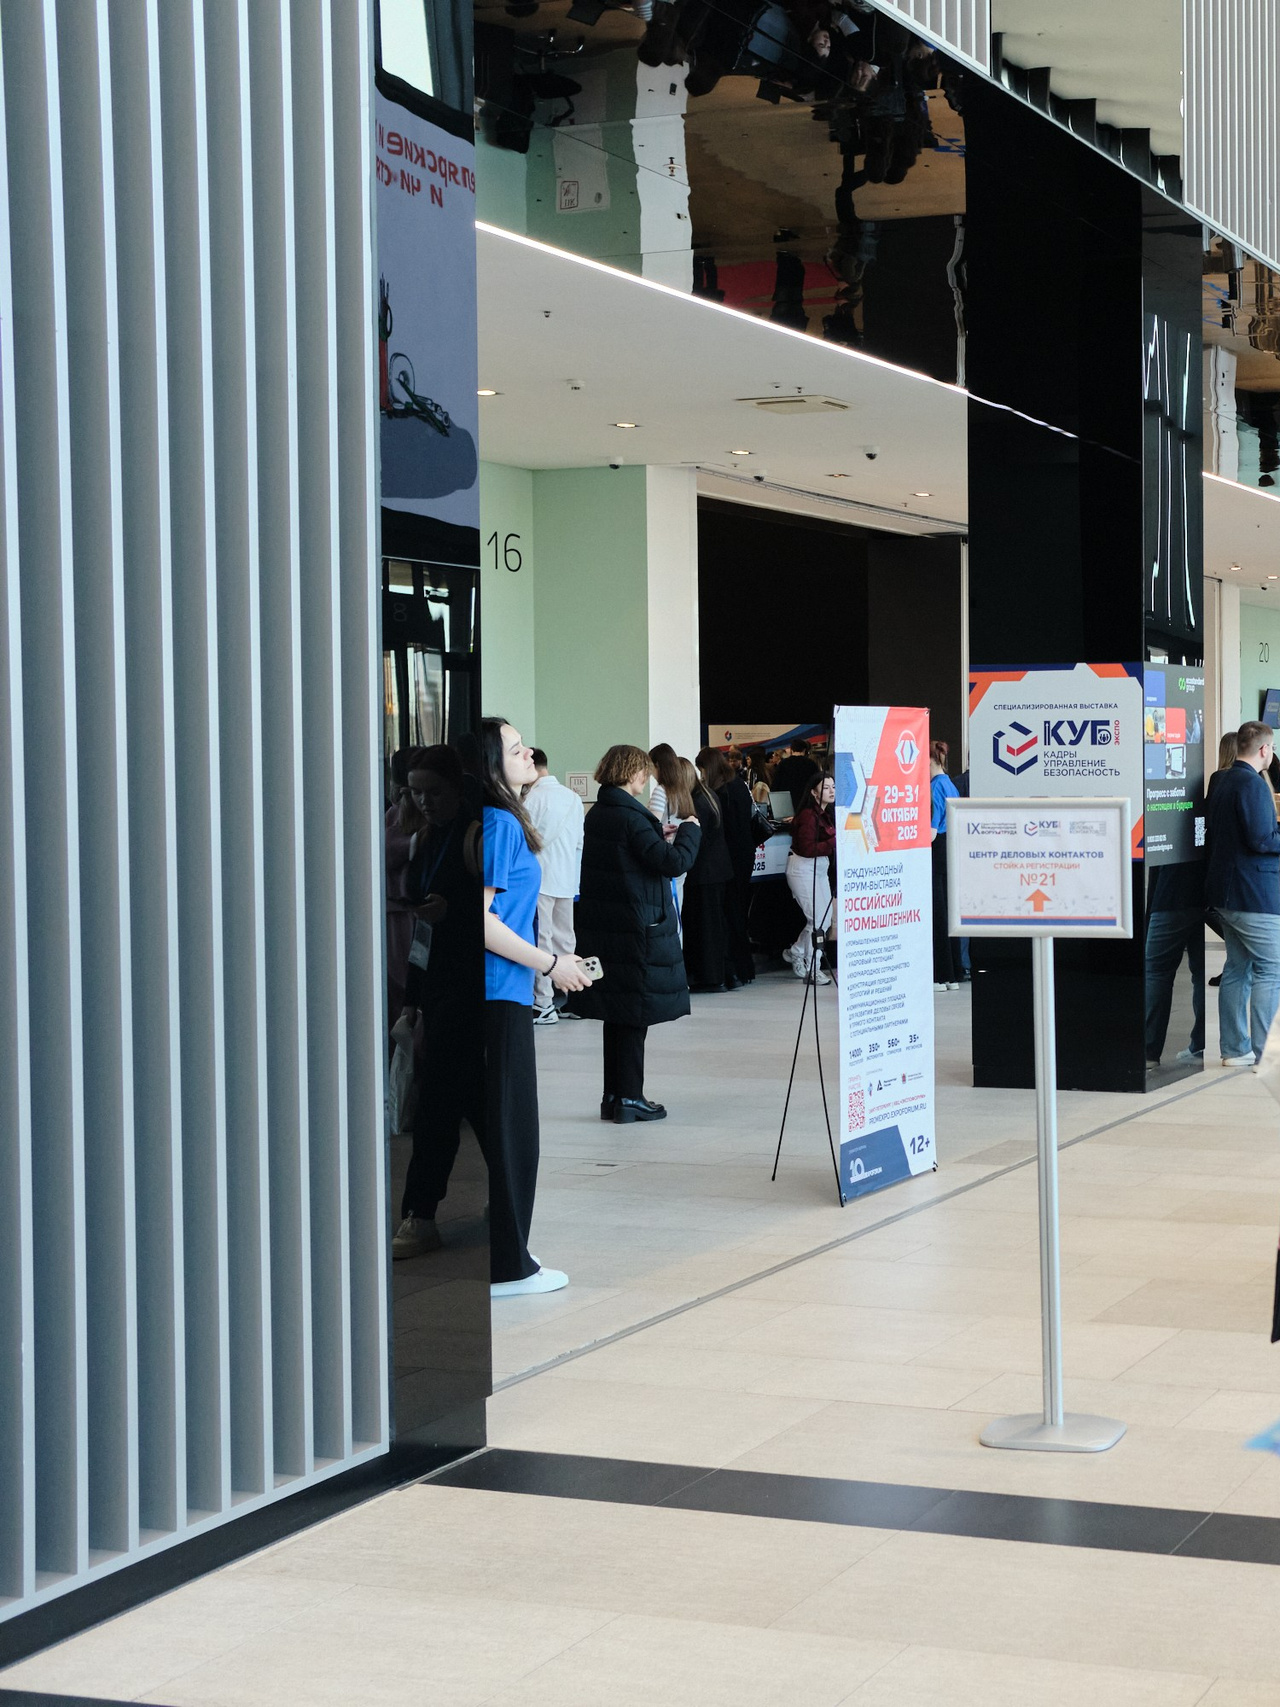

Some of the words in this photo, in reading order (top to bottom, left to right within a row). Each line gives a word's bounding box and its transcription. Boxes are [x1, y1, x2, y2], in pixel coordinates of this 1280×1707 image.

[486, 531, 522, 572] 16
[1258, 642, 1269, 663] 20
[993, 703, 1078, 711] СПЕЦИАЛИЗИРОВАННАЯ
[1079, 702, 1119, 710] ВЫСТАВКА
[1043, 720, 1112, 746] КУБ
[1043, 751, 1077, 760] КАДРЫ
[1043, 760, 1107, 768] УПРАВЛЕНИЕ
[1043, 768, 1121, 777] БЕЗОПАСНОСТЬ
[884, 784, 919, 804] 29-31
[881, 807, 919, 823] ОКТЯБРЯ
[897, 825, 918, 841] 2025
[967, 823, 980, 835] IX
[1039, 821, 1058, 829] КУБ
[969, 851, 998, 860] ЦЕНТР
[1000, 851, 1046, 860] ДЕЛОВЫХ
[1048, 851, 1104, 859] КОНТАКТОВ
[993, 862, 1025, 870] СТОЙКА
[845, 890, 902, 913] РОССИЙСКИЙ
[844, 909, 921, 933] ПРОМЫШЛЕННИК
[909, 1134, 930, 1155] 12+
